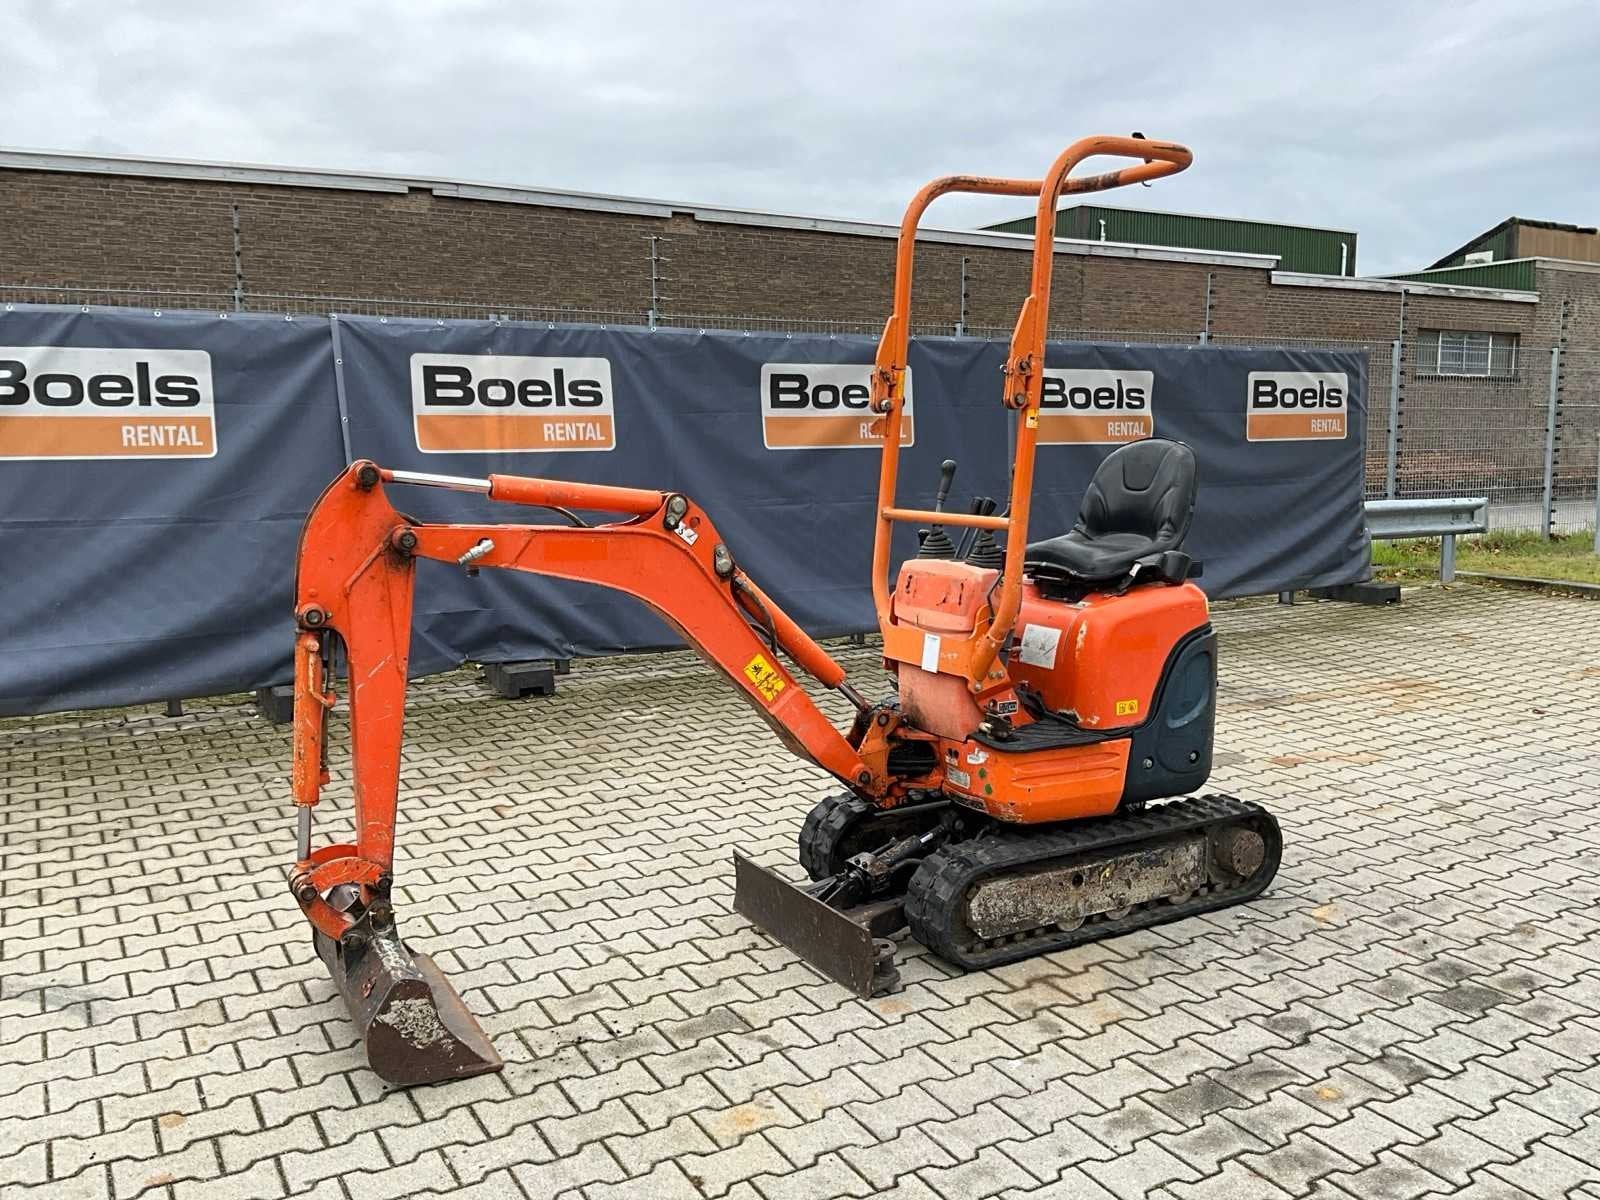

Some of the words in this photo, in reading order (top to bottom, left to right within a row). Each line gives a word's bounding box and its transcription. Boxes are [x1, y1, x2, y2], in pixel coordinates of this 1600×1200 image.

[423, 365, 604, 407] Boels
[770, 373, 906, 409] Boe
[1040, 377, 1145, 409] Boels
[1252, 379, 1343, 408] Boels
[121, 424, 204, 447] RENTAL
[543, 423, 606, 441] RENTAL
[1107, 422, 1146, 436] RENTAL
[1311, 418, 1343, 433] RENTAL
